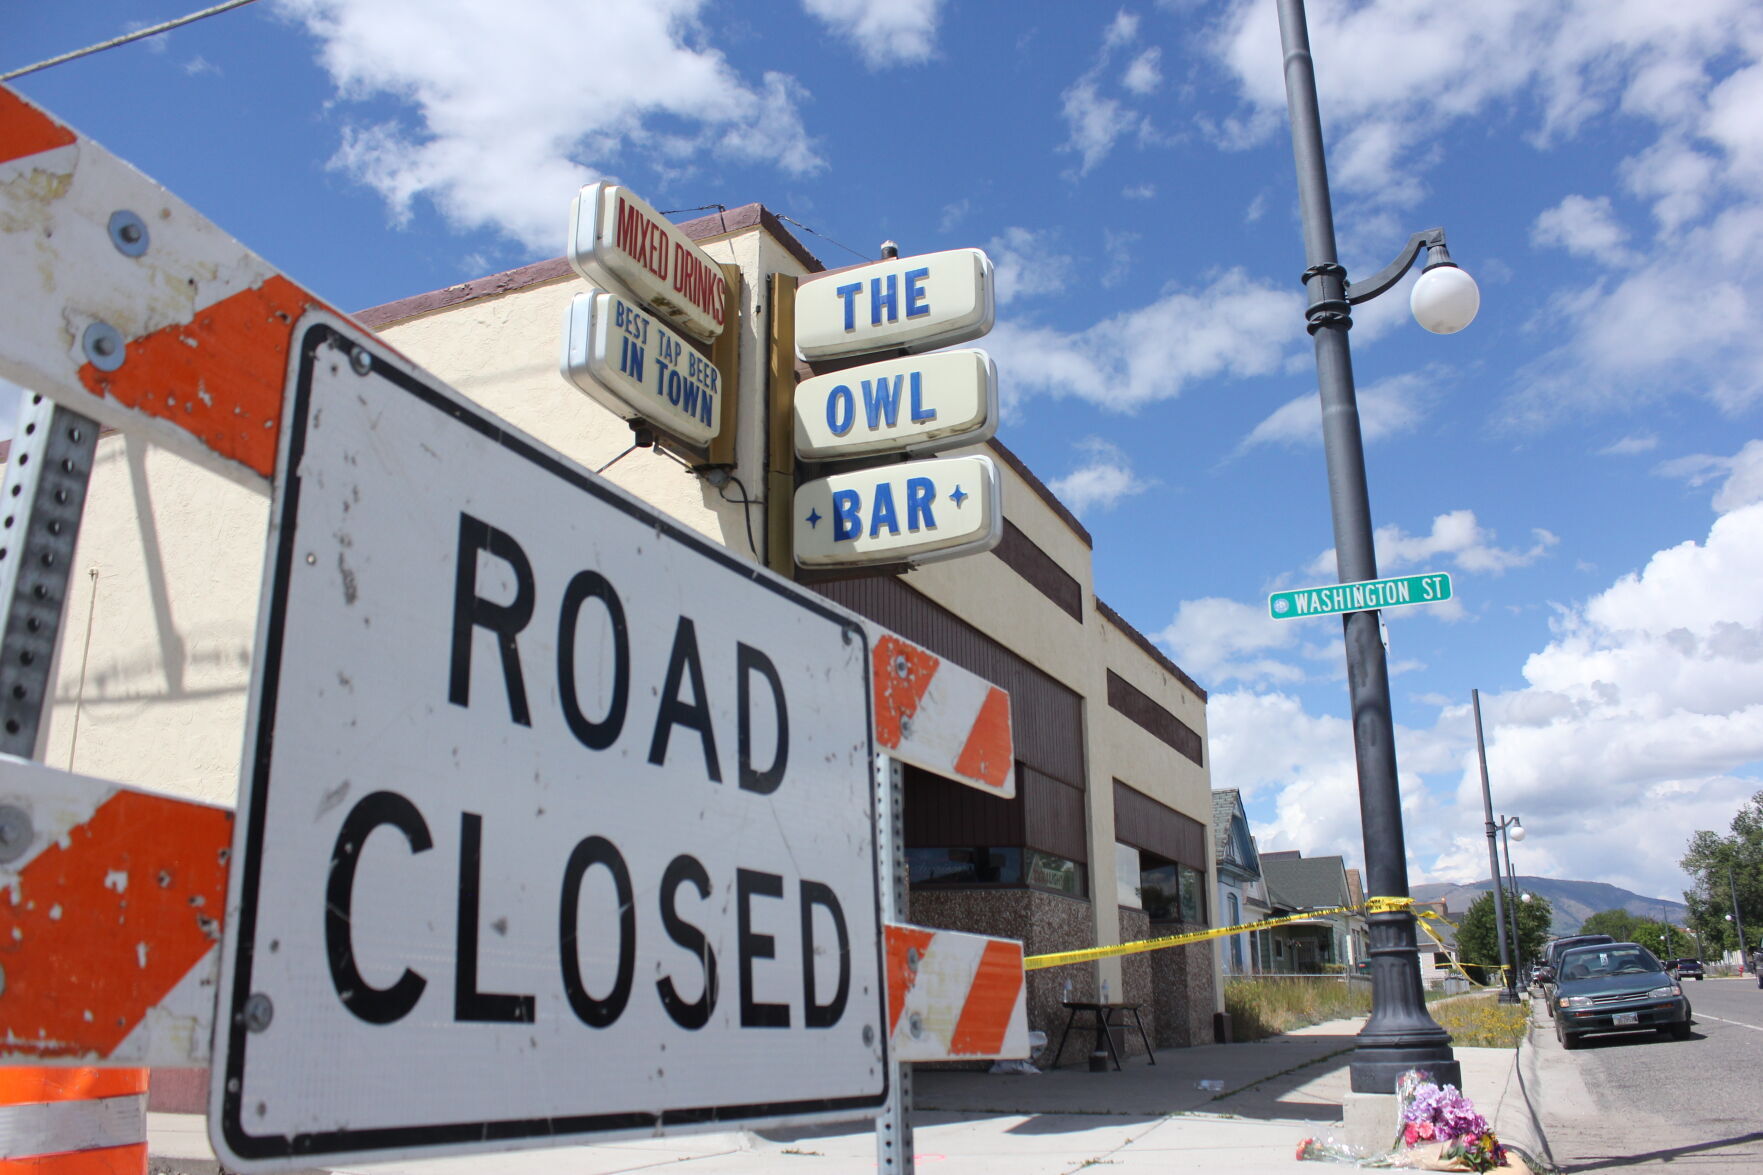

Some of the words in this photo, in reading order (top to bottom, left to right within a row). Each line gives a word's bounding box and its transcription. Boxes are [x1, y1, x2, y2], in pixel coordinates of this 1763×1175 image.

[616, 196, 669, 281] MIXED
[673, 241, 726, 326] DRINKS
[836, 267, 930, 333] THE
[615, 300, 650, 345] BEST
[658, 329, 682, 367] TAP
[688, 351, 718, 394] BEER
[620, 335, 645, 384] IN
[655, 357, 713, 428] TOWN
[826, 371, 937, 438] OWL
[832, 476, 937, 543] BAR
[1294, 581, 1410, 614] WASHINGTON
[1421, 577, 1442, 600] ST
[447, 511, 790, 796] ROAD
[324, 790, 852, 1030] CLOSED
